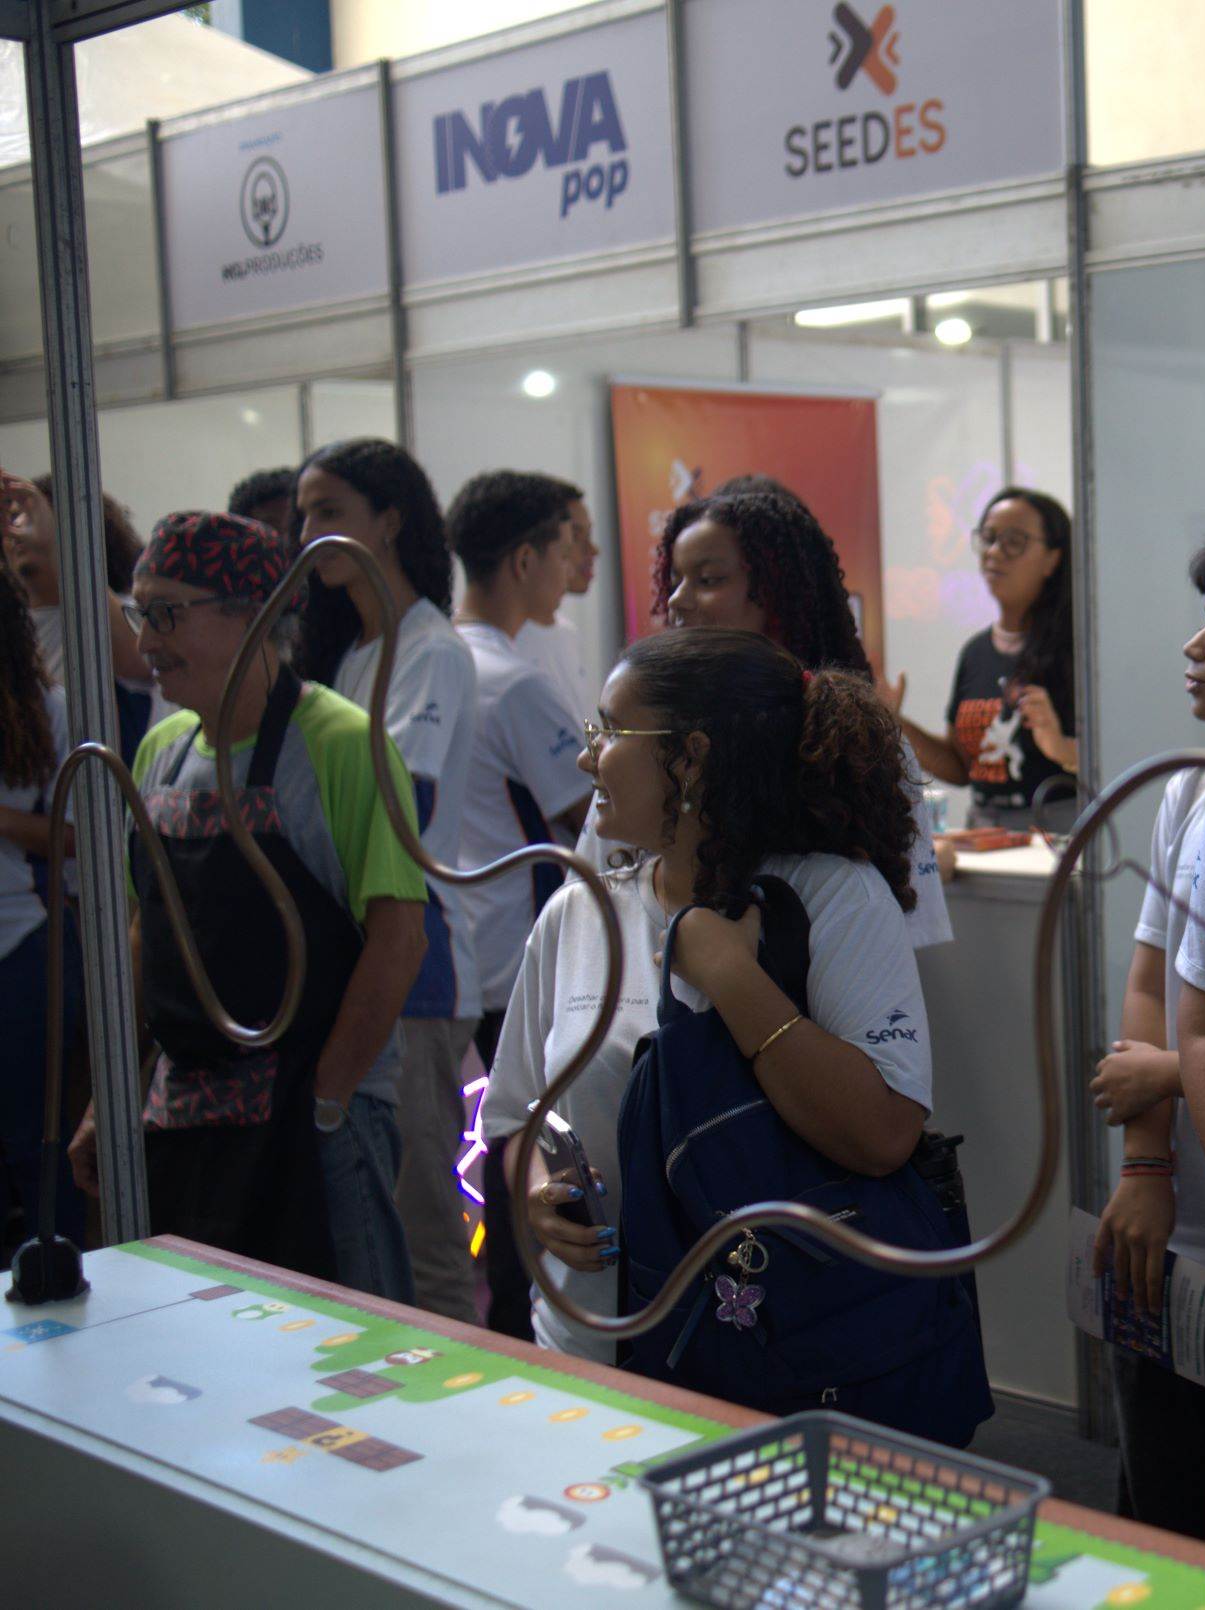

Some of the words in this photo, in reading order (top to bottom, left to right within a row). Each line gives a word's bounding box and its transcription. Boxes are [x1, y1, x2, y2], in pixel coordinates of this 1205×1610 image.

[434, 69, 627, 194] INOVA
[785, 98, 947, 178] SEEDES
[560, 158, 629, 219] pop
